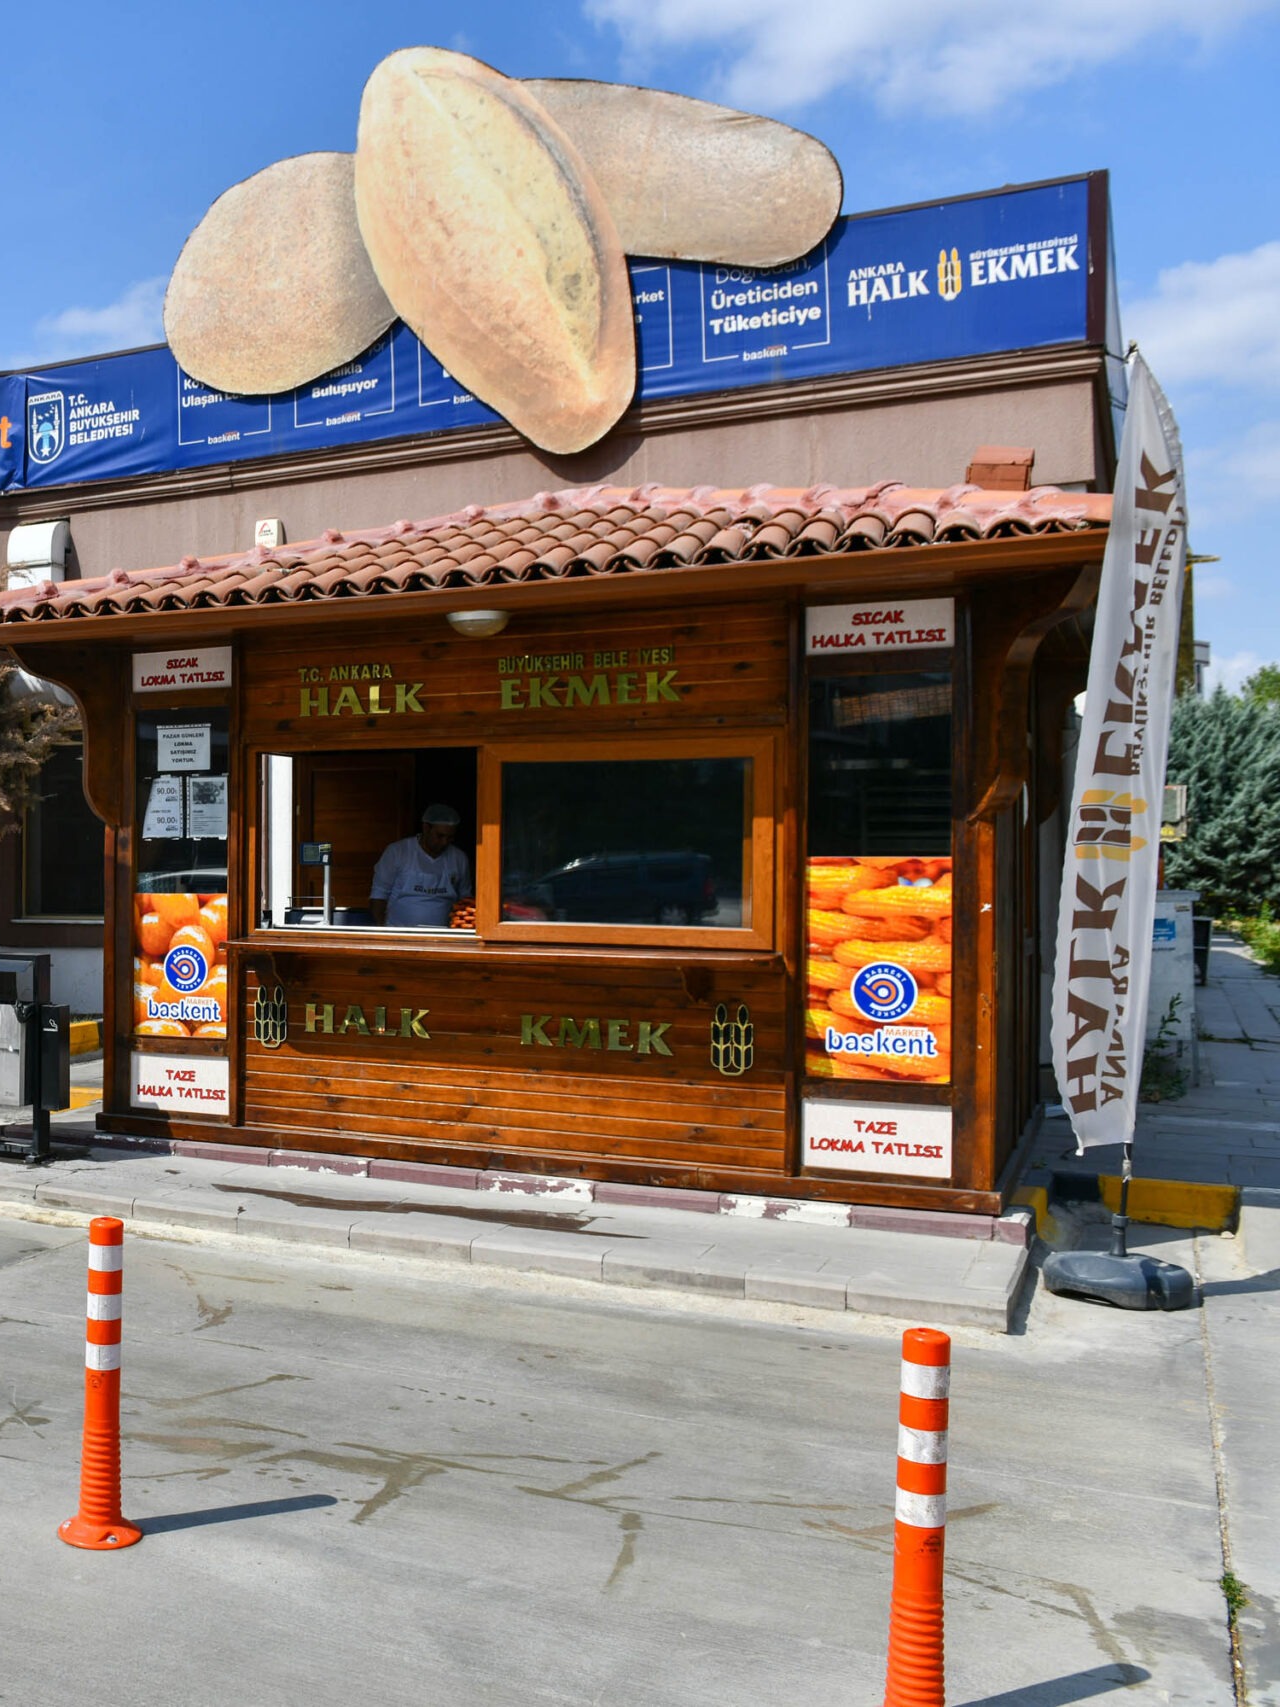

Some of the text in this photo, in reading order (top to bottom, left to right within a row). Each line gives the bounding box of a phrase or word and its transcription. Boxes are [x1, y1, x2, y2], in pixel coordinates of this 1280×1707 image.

[847, 245, 1080, 307] HALK EKMEK
[848, 261, 905, 280] ANKARA
[711, 280, 818, 310] Üreticiden
[709, 306, 821, 335] Tüketiciye
[312, 378, 378, 398] Buluşuyor
[29, 392, 62, 404] ANKARA
[68, 393, 88, 407] T.C.
[182, 393, 223, 408] Ulaşan
[69, 401, 116, 420] ANKARA
[851, 610, 904, 626] SICAK
[812, 628, 946, 649] HALKA TATLISI
[166, 657, 199, 670] SICAK
[141, 671, 225, 687] LOKMA TATLISI
[298, 667, 323, 682] T.C.
[329, 664, 393, 681] ANKARA
[299, 669, 682, 717] HALK EKMEK
[303, 1003, 431, 1040] HALK
[885, 1027, 926, 1038] MARKET
[166, 1069, 196, 1082] TAZE
[137, 1085, 226, 1101] HALKA TATLISI
[854, 1120, 898, 1136] TAZE
[810, 1137, 943, 1159] LOKMA TATLISI
